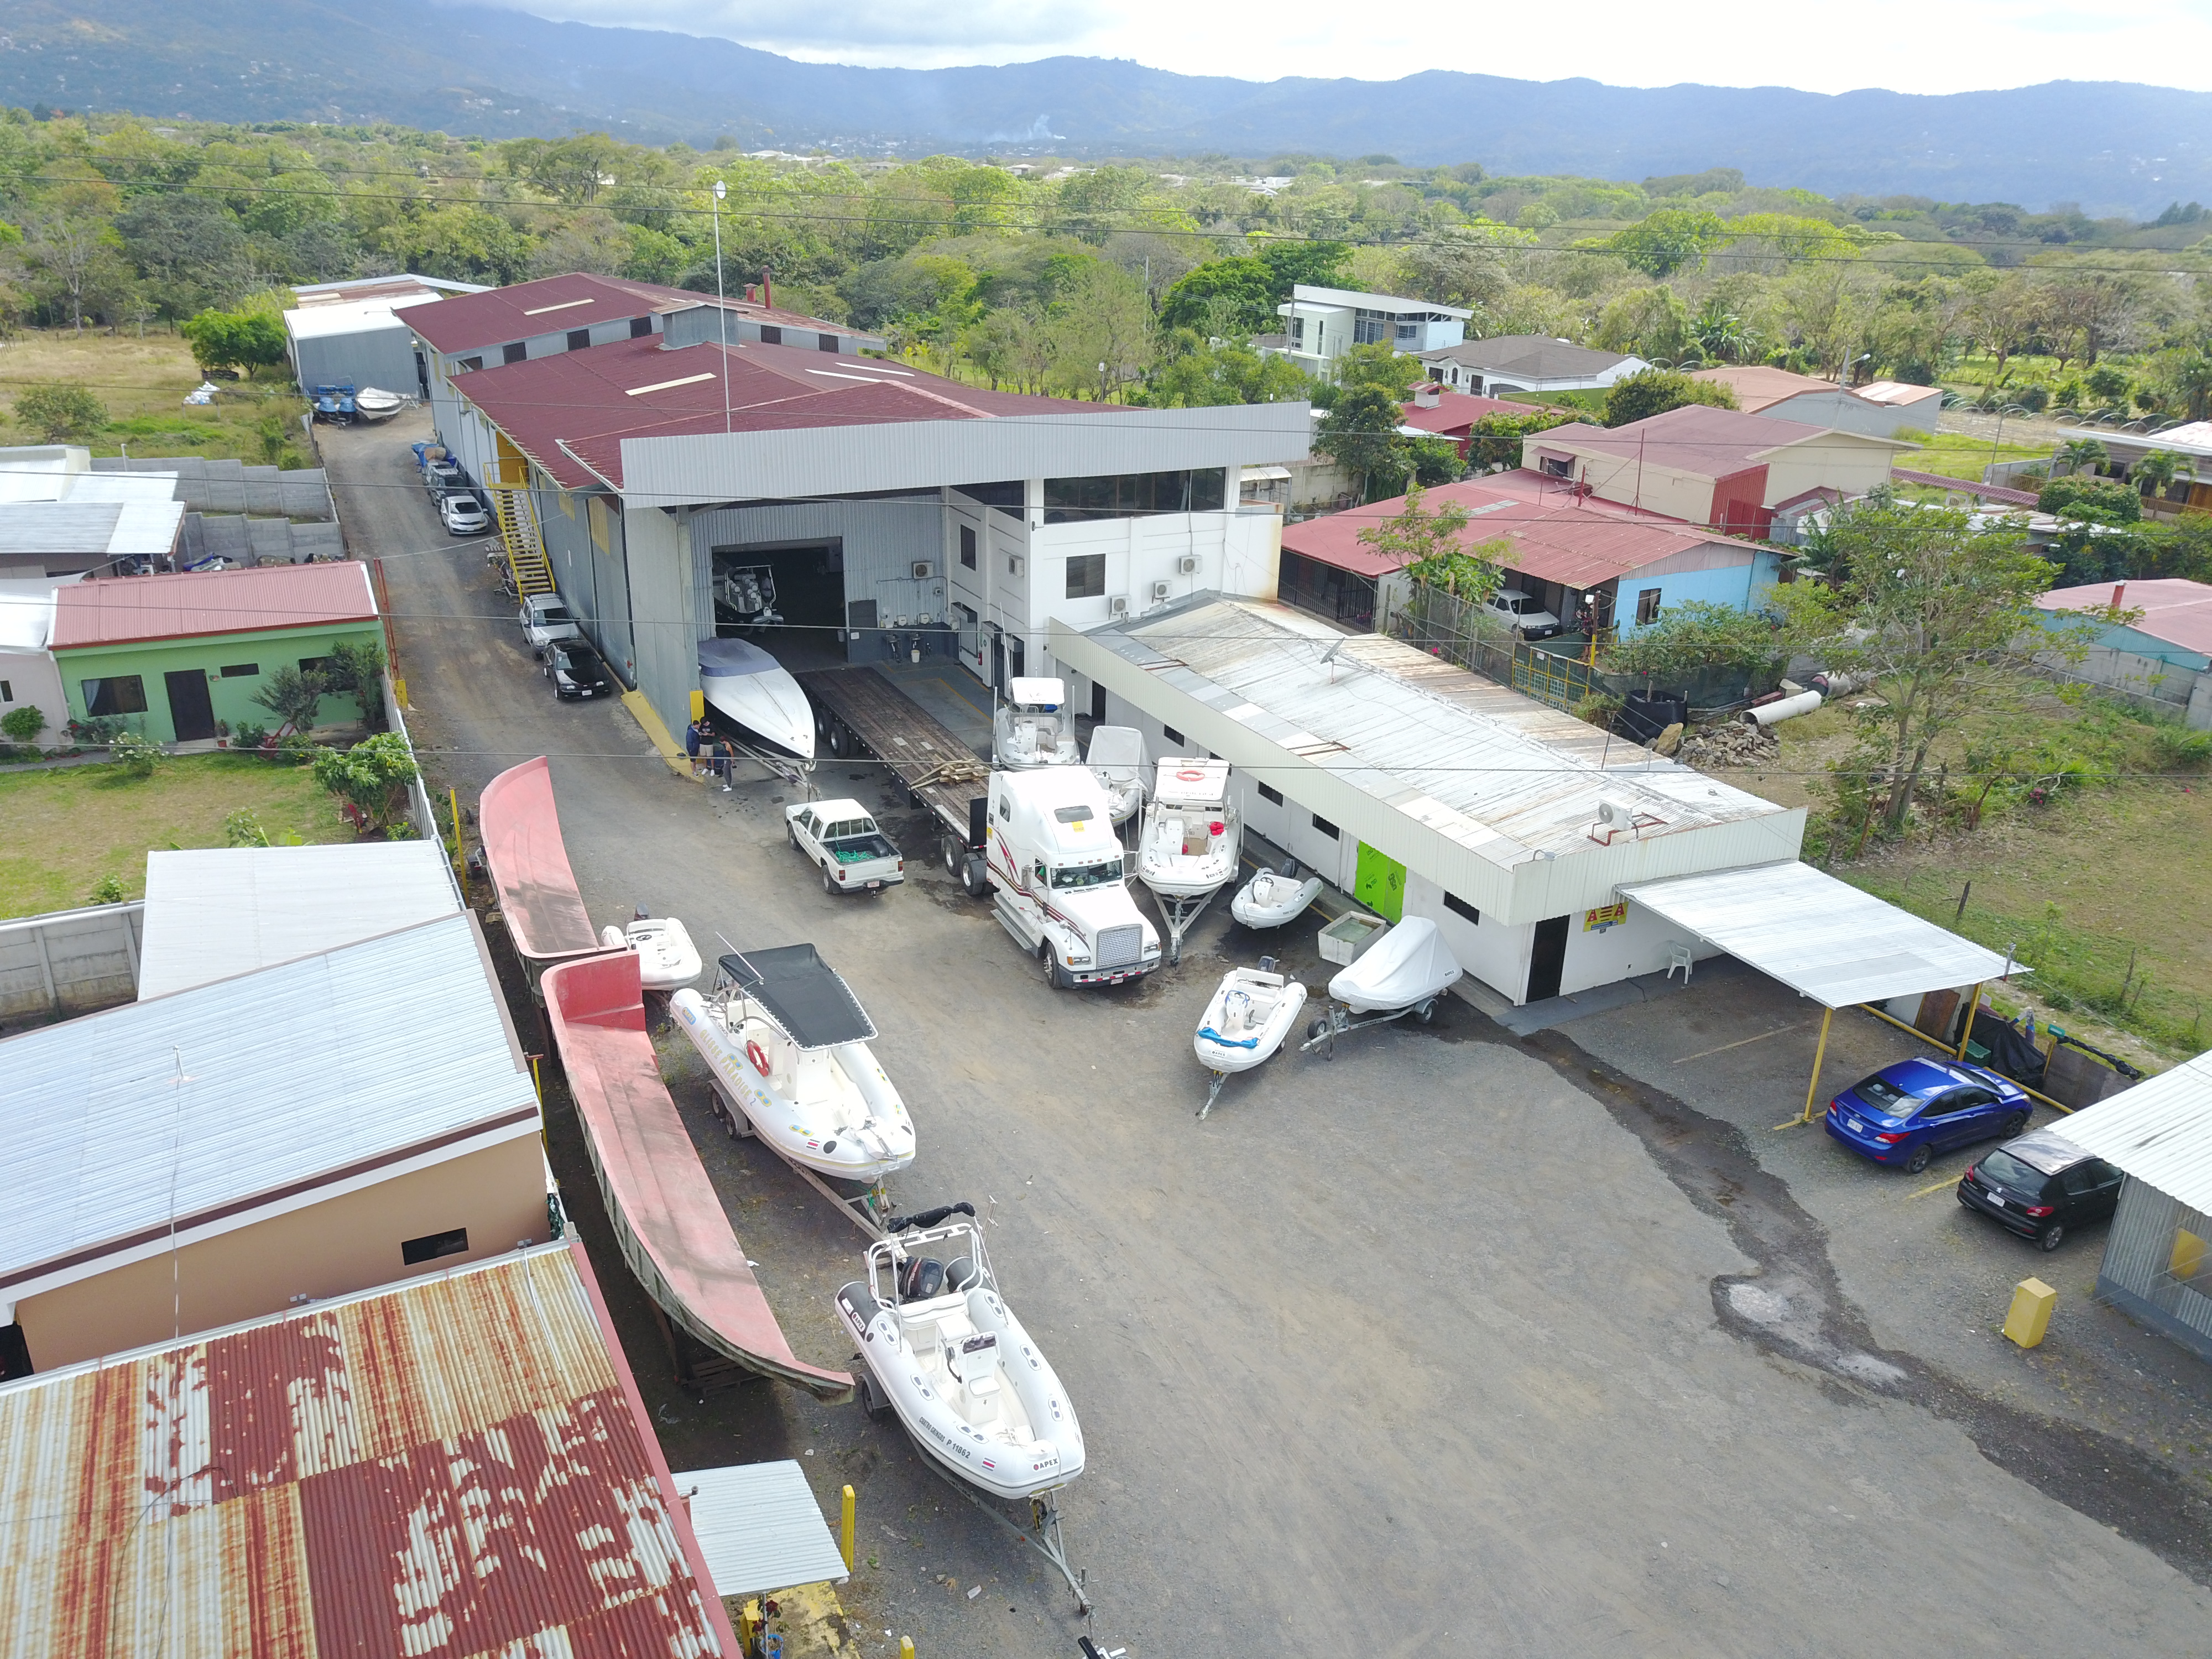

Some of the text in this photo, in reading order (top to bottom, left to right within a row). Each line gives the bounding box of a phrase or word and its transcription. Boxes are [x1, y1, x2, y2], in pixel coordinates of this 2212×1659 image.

[700, 1029, 723, 1059] GLISSE
[719, 1056, 753, 1100] PARADISE
[749, 1098, 757, 1107] 2
[855, 1317, 864, 1331] APEX
[952, 1443, 971, 1459] 11862
[1040, 1458, 1058, 1469] APEX
